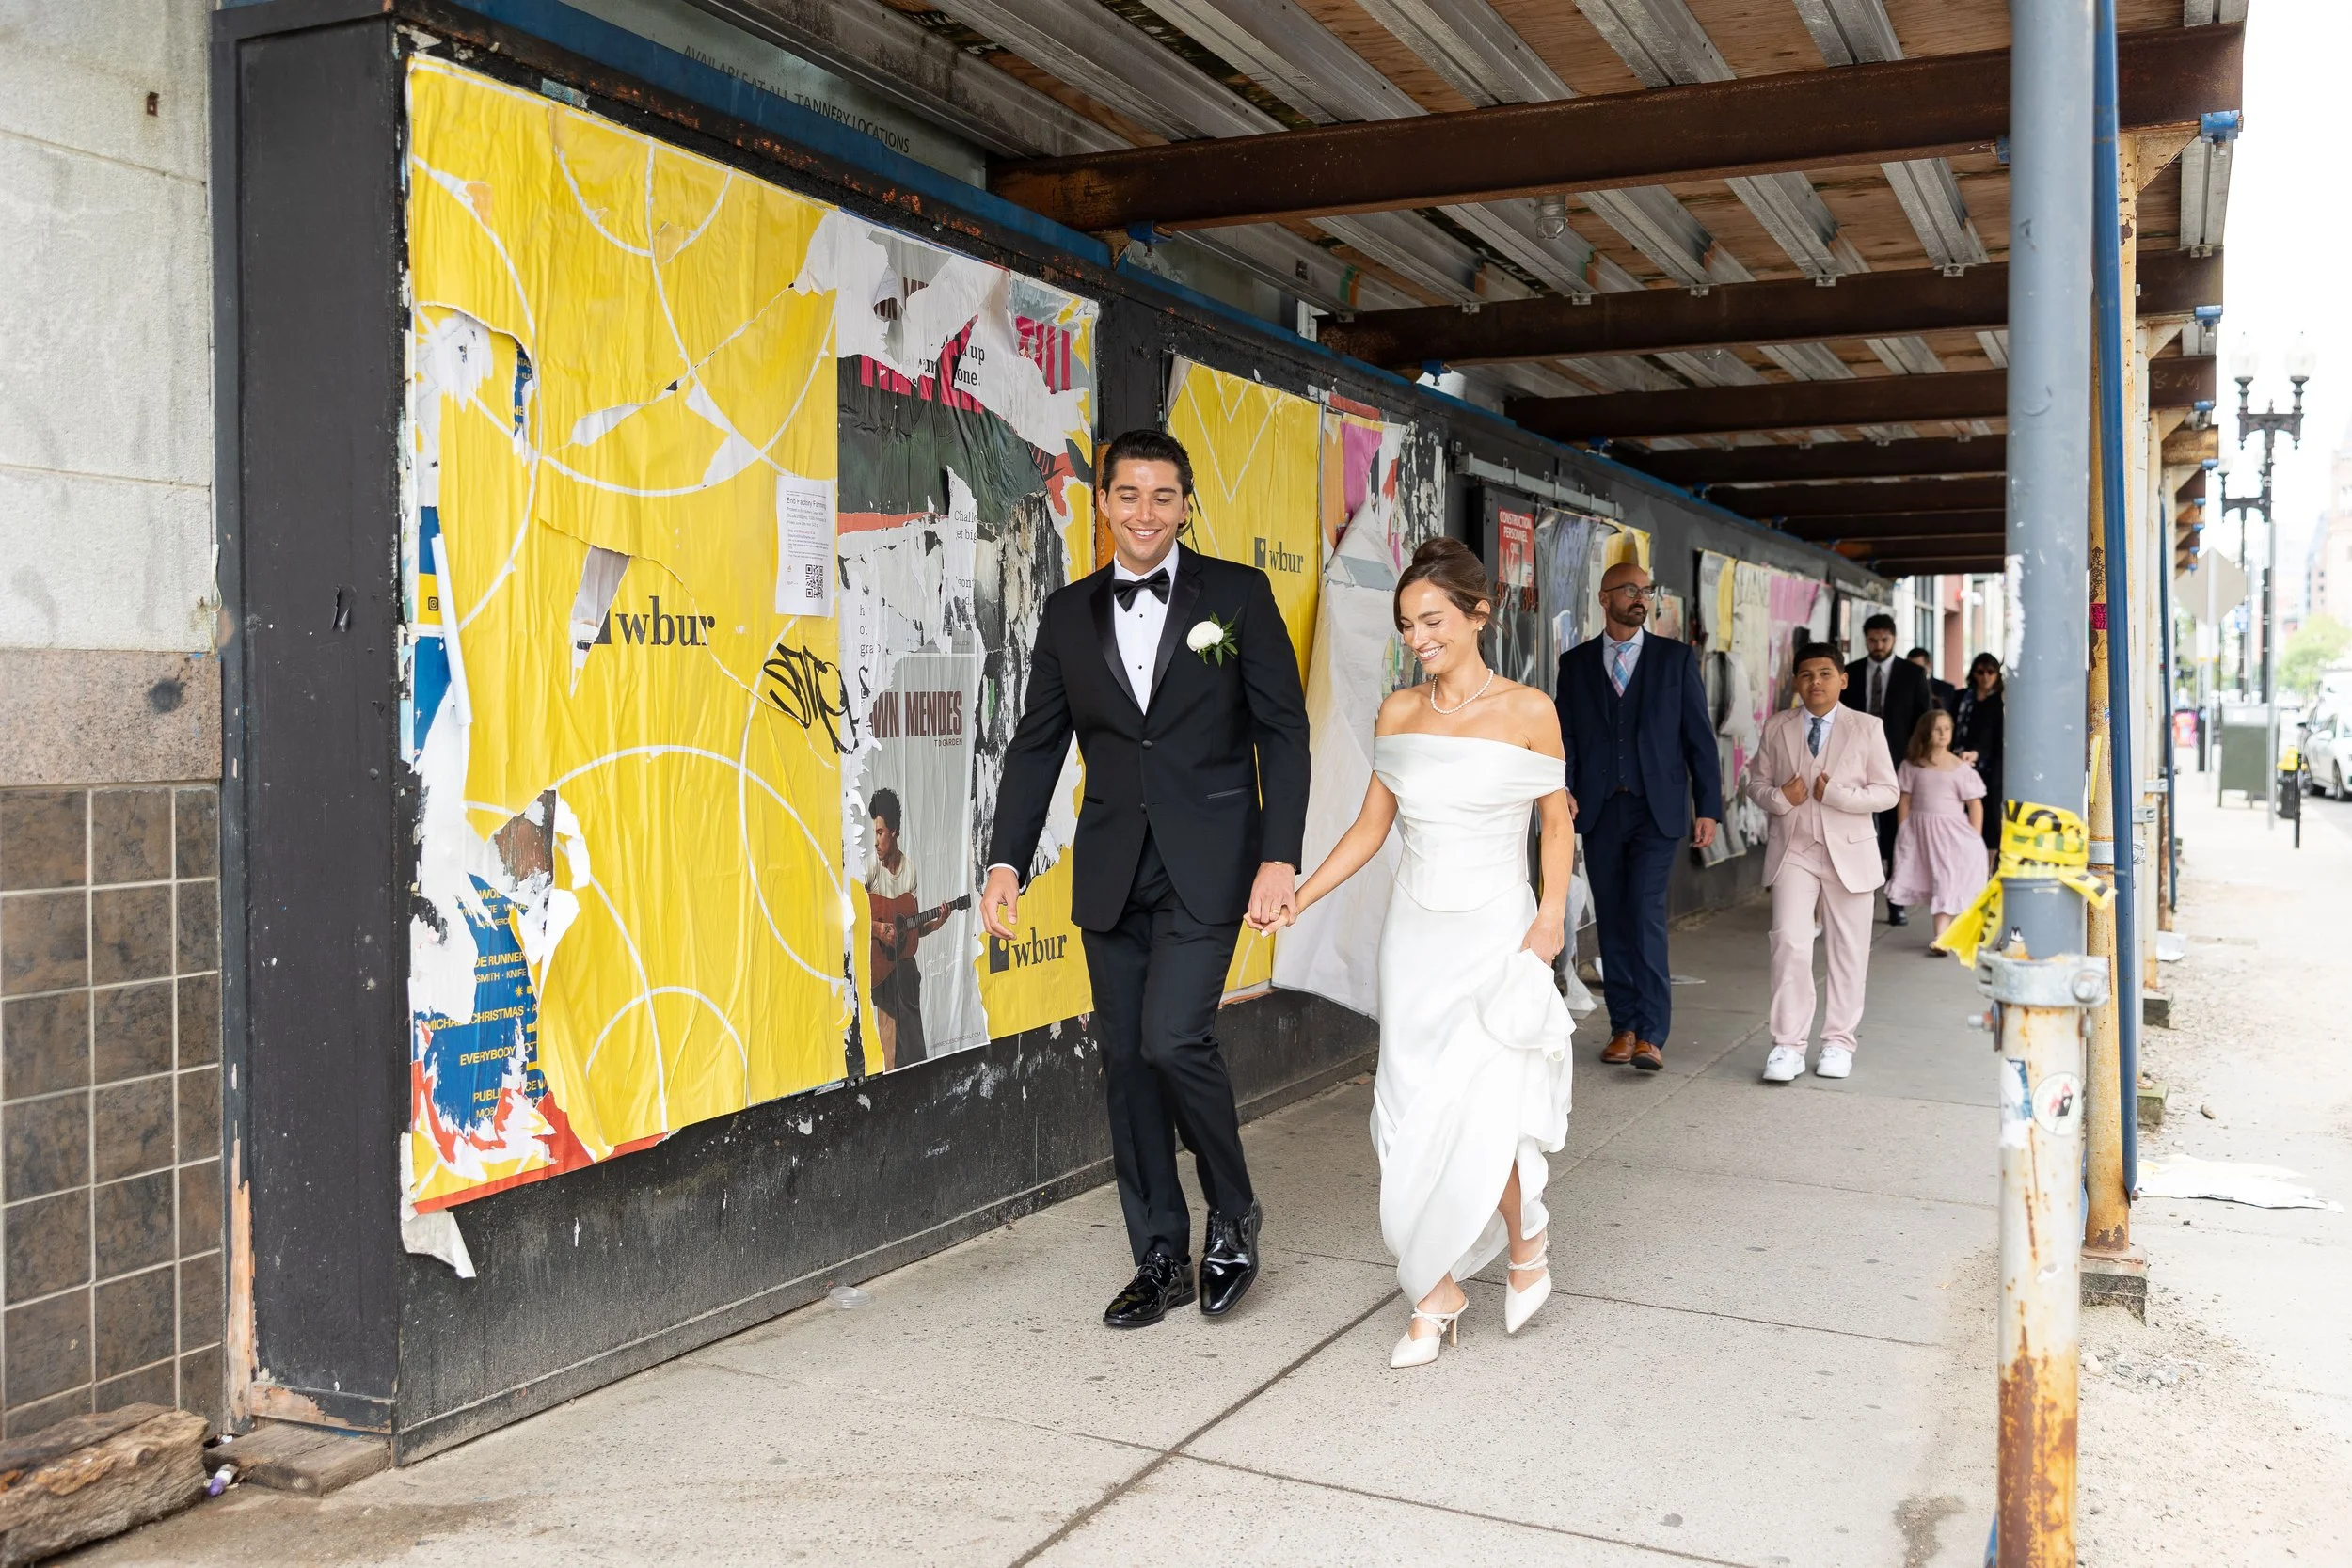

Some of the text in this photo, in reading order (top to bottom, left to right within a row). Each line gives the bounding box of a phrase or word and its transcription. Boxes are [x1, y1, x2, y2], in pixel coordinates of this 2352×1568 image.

[851, 114, 910, 154] LOCATIONS
[971, 345, 985, 365] up
[1500, 511, 1532, 530] CONSTRUCTION
[1269, 541, 1303, 573] wbur
[615, 595, 716, 646] wbur
[905, 690, 963, 737] MENDES
[942, 738, 963, 747] GARDEN
[1011, 927, 1067, 968] wbur
[470, 1006, 524, 1024] CHRISTMAS
[460, 1046, 516, 1066] EVERYBODY
